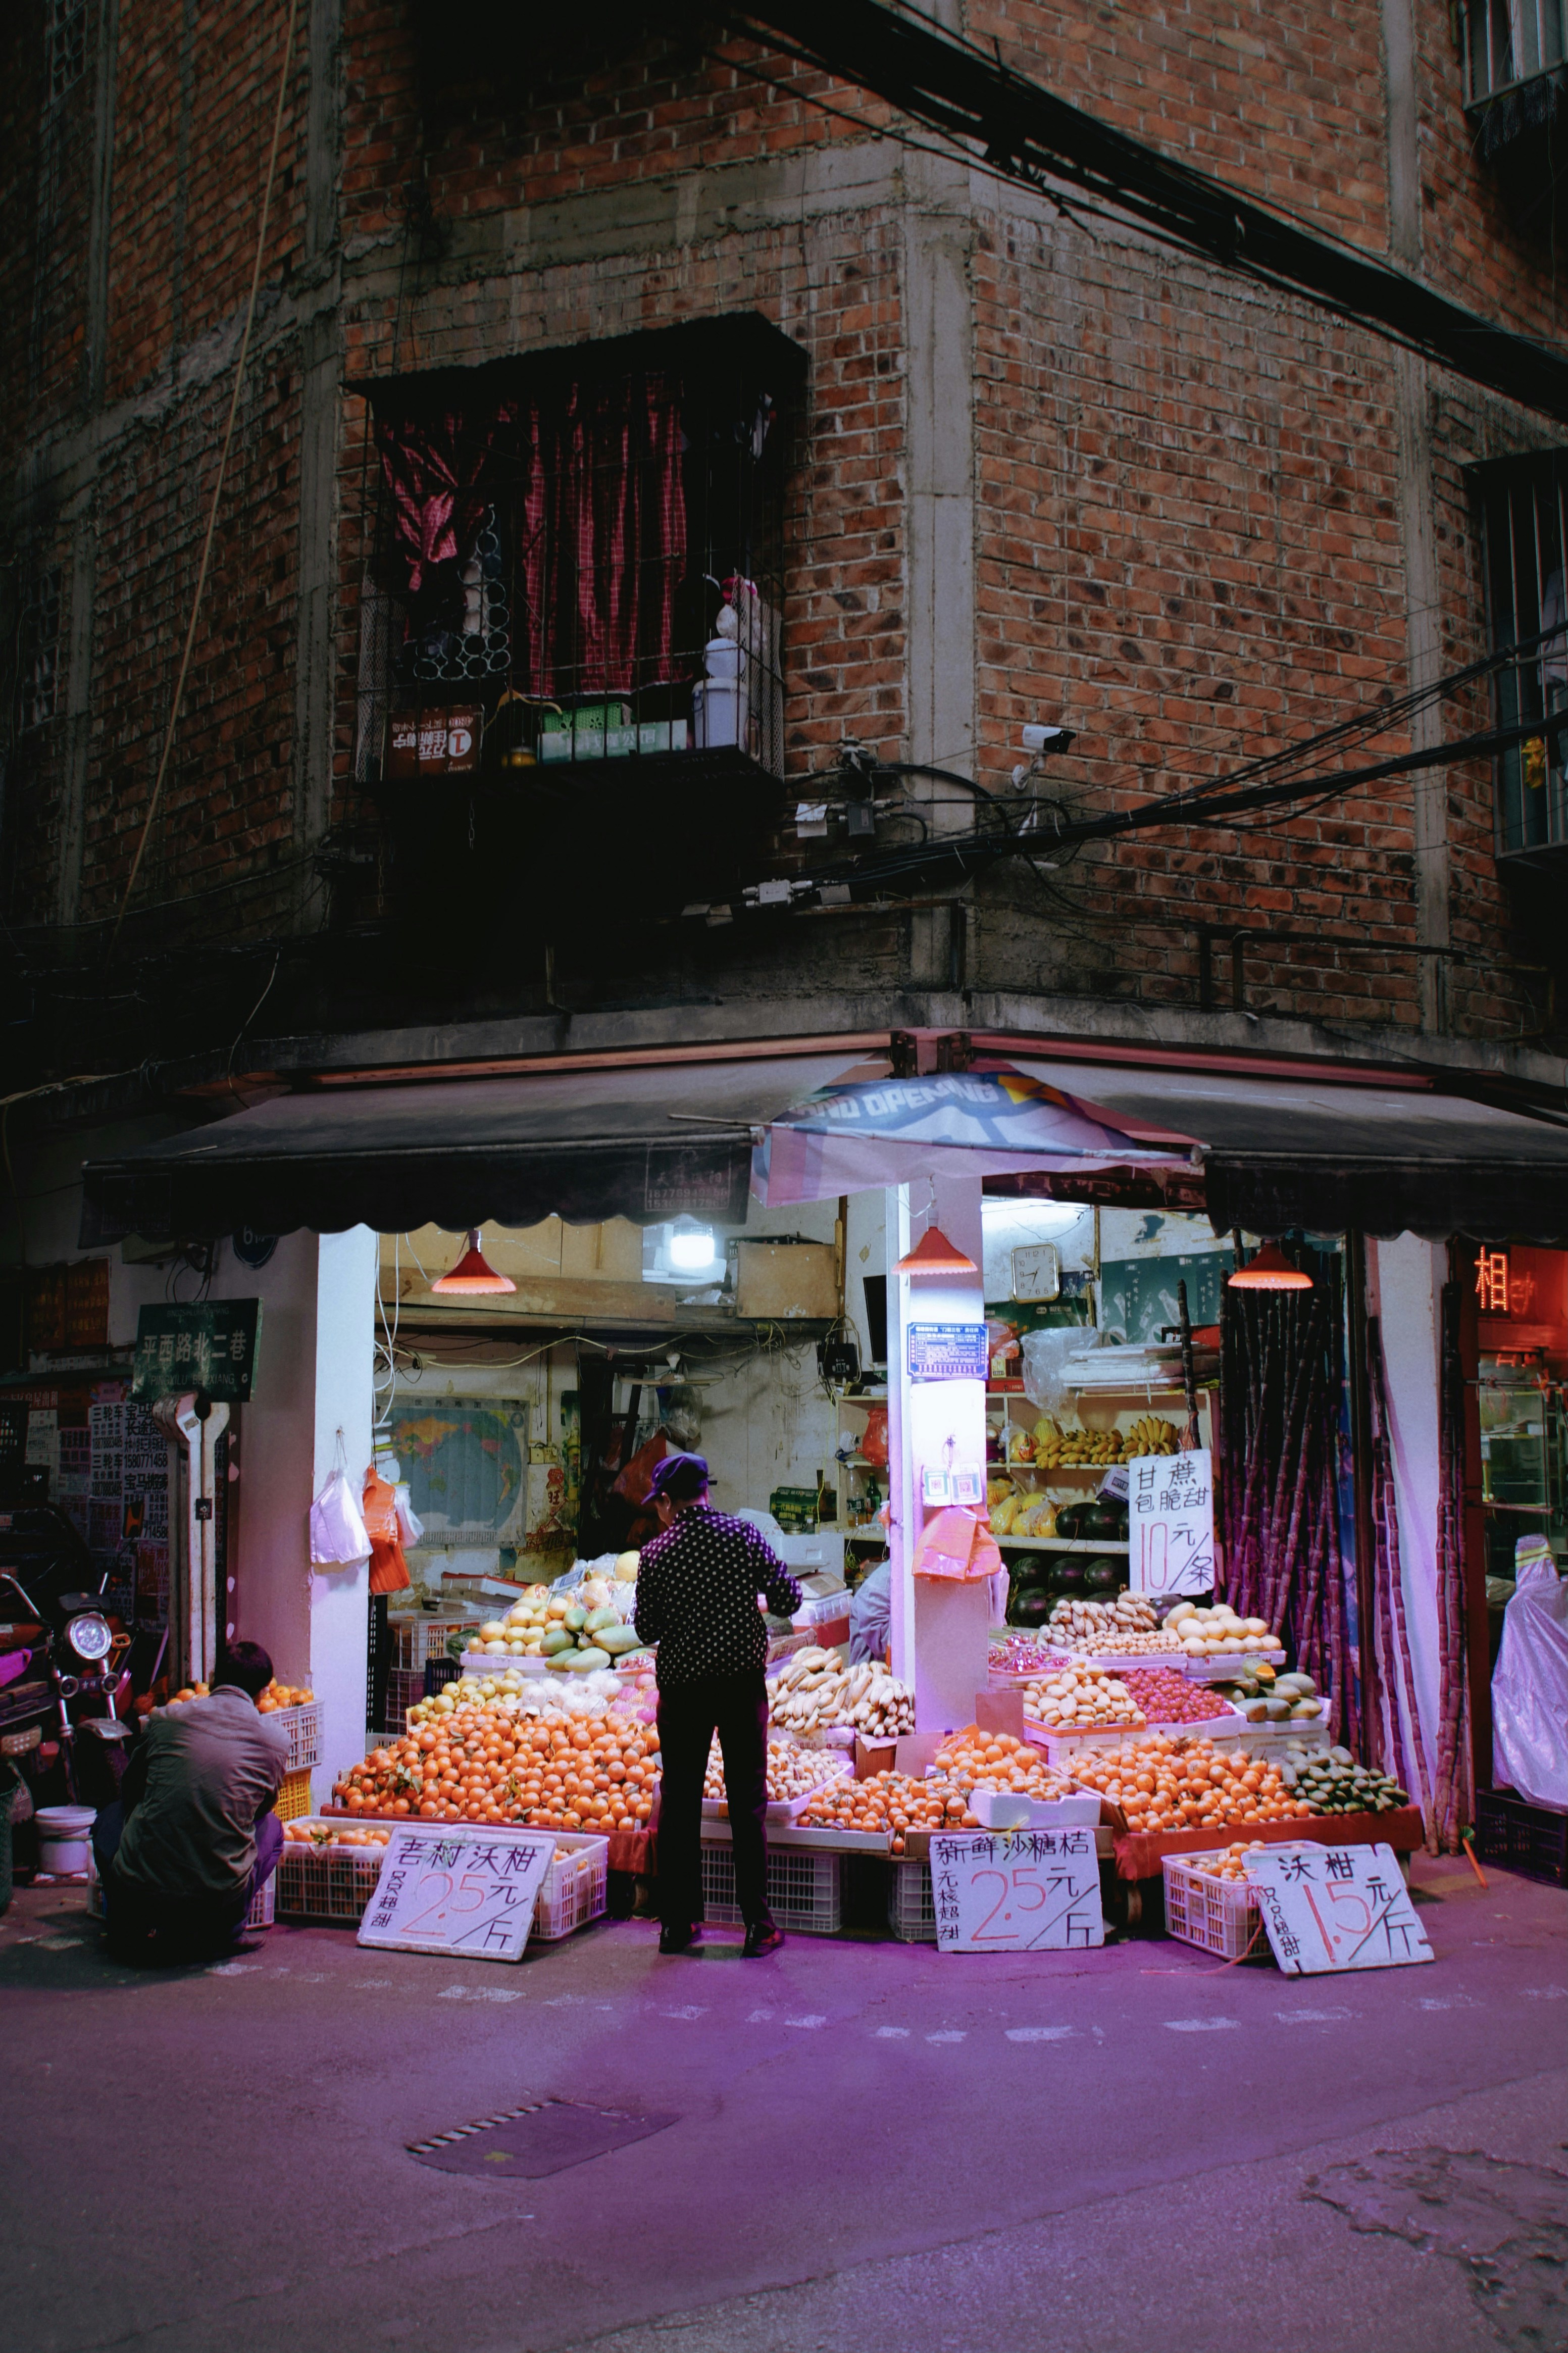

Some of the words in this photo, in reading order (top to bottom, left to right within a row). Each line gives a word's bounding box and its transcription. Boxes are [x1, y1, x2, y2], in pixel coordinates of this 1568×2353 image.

[418, 745, 446, 760] 万元
[863, 1075, 999, 1117] OPENING
[142, 1330, 247, 1363] 平西路北二巷
[151, 1374, 188, 1386] PINGXILU
[93, 1404, 123, 1421] 三轮车
[92, 1453, 123, 1470] 三轮车
[125, 1473, 168, 1490] 宝马搬家
[1137, 1461, 1196, 1490] 甘蔗
[1135, 1487, 1209, 1513] 包脆甜
[394, 1839, 537, 1876] 老村沃柑
[935, 1831, 1063, 1865] 新鲜沙糖桔
[1278, 1853, 1355, 1882] 沃柑
